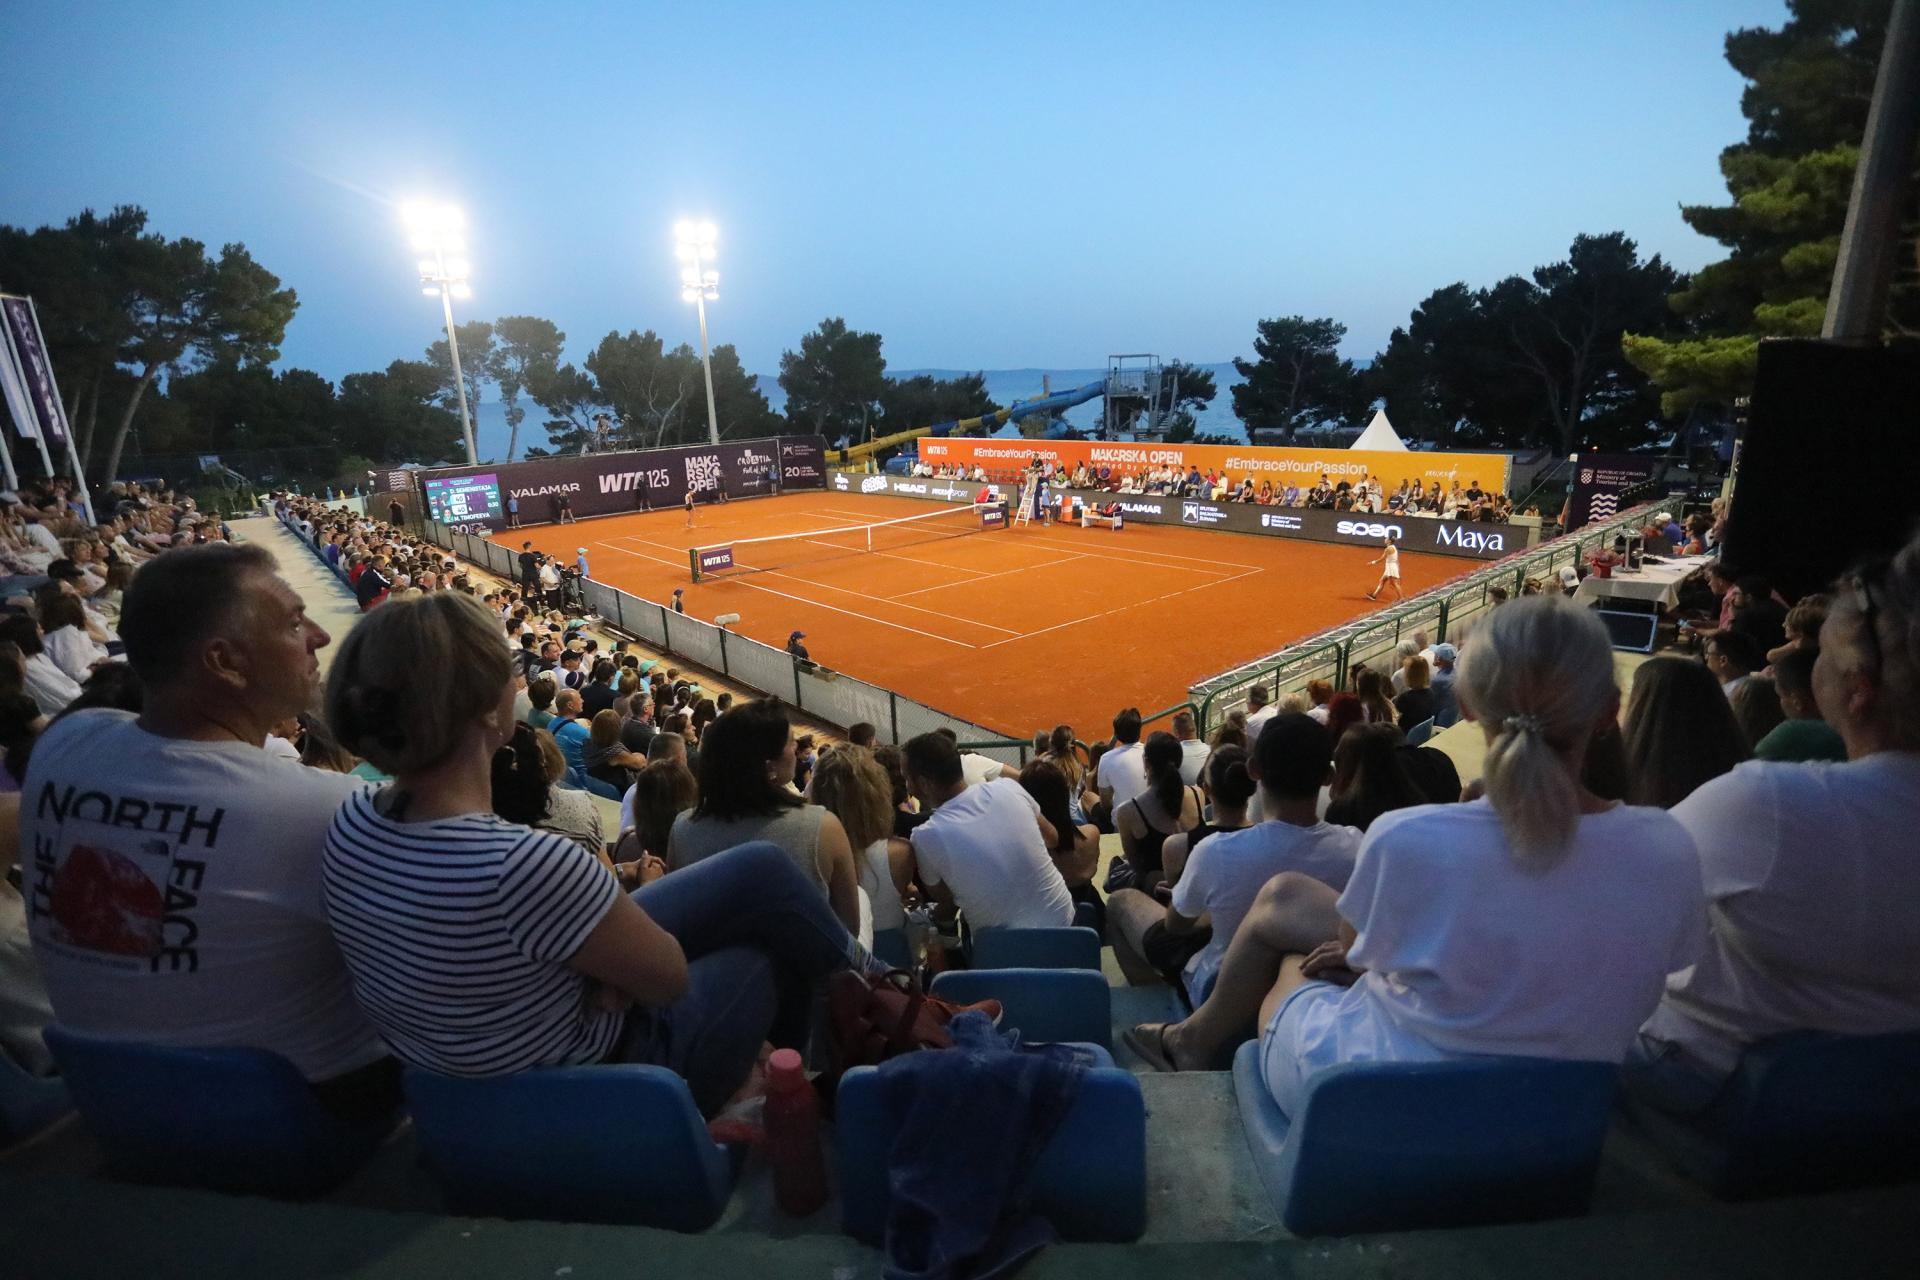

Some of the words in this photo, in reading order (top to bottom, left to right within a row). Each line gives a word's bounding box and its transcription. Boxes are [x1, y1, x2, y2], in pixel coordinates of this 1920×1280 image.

[685, 455, 720, 469] MAKA
[738, 455, 772, 465] CROATIA
[1090, 448, 1148, 462] MAKARSKA
[1150, 451, 1183, 464] OPEN
[785, 466, 800, 477] 20
[1226, 458, 1367, 475] #EmbraceYourPassion
[646, 469, 670, 488] 125
[510, 482, 580, 498] VALAMAR
[894, 483, 927, 493] HEAD
[1436, 524, 1503, 554] Maya
[704, 556, 721, 566] WTA
[38, 780, 225, 848] NORTH
[151, 858, 206, 972] FACE
